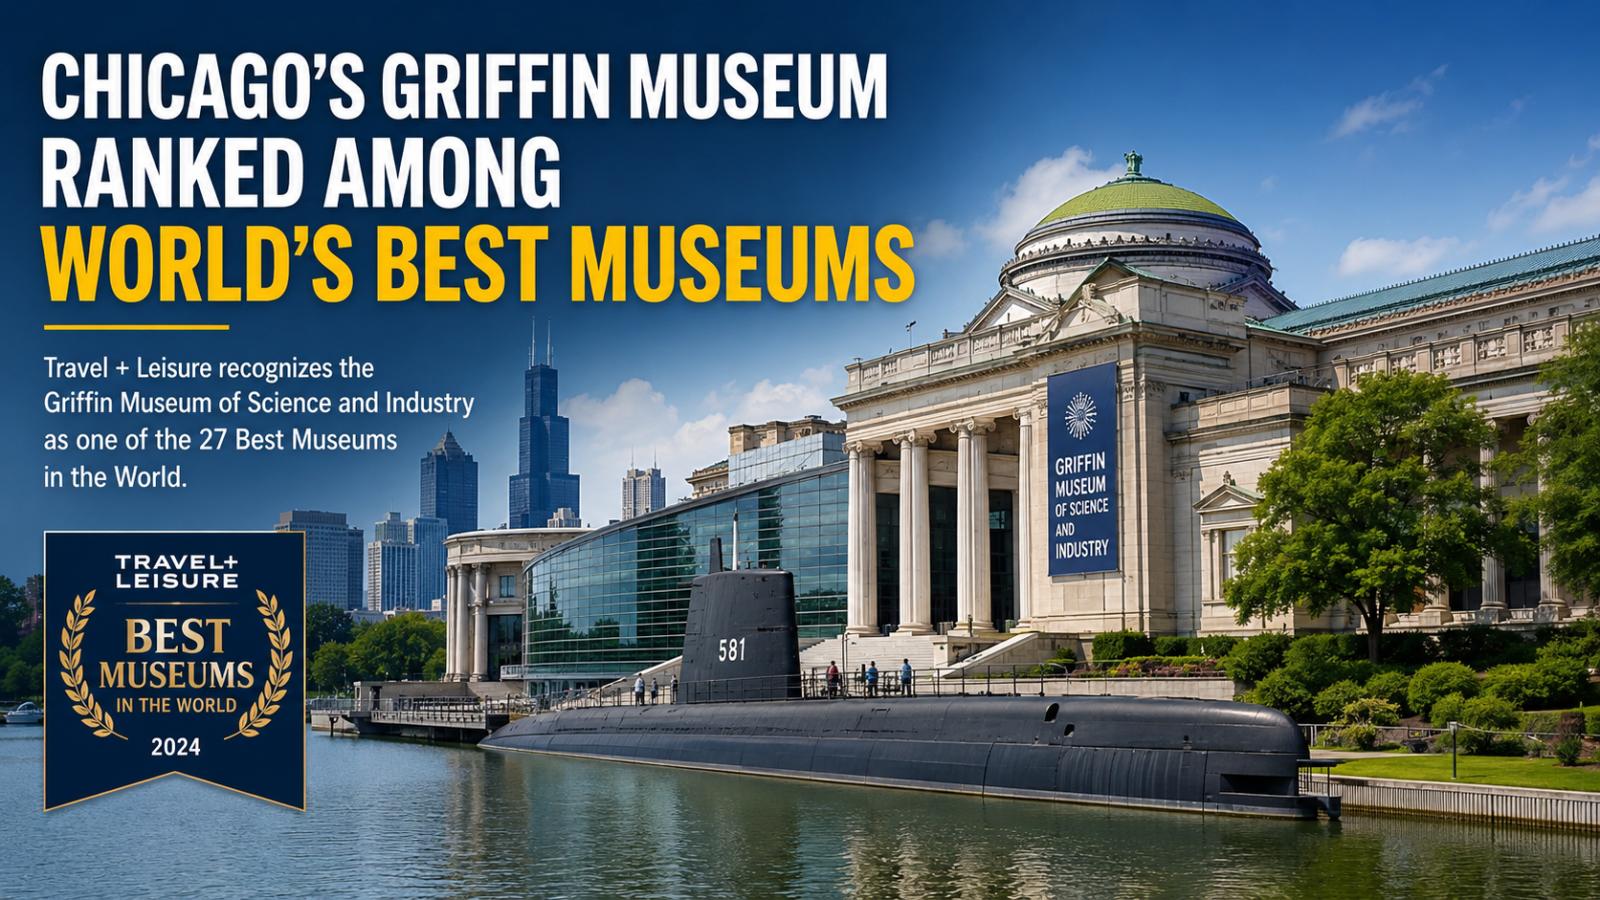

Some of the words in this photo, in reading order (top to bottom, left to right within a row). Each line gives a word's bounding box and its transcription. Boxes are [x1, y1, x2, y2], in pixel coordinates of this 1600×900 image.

[1056, 452, 1105, 475] GRIFFIN
[1056, 475, 1106, 498] MUSEUM
[1056, 503, 1067, 517] OF
[1070, 498, 1108, 515] SCIENCE
[1056, 523, 1074, 536] AND
[1056, 539, 1108, 559] INDUSTRY
[719, 638, 745, 661] 581
